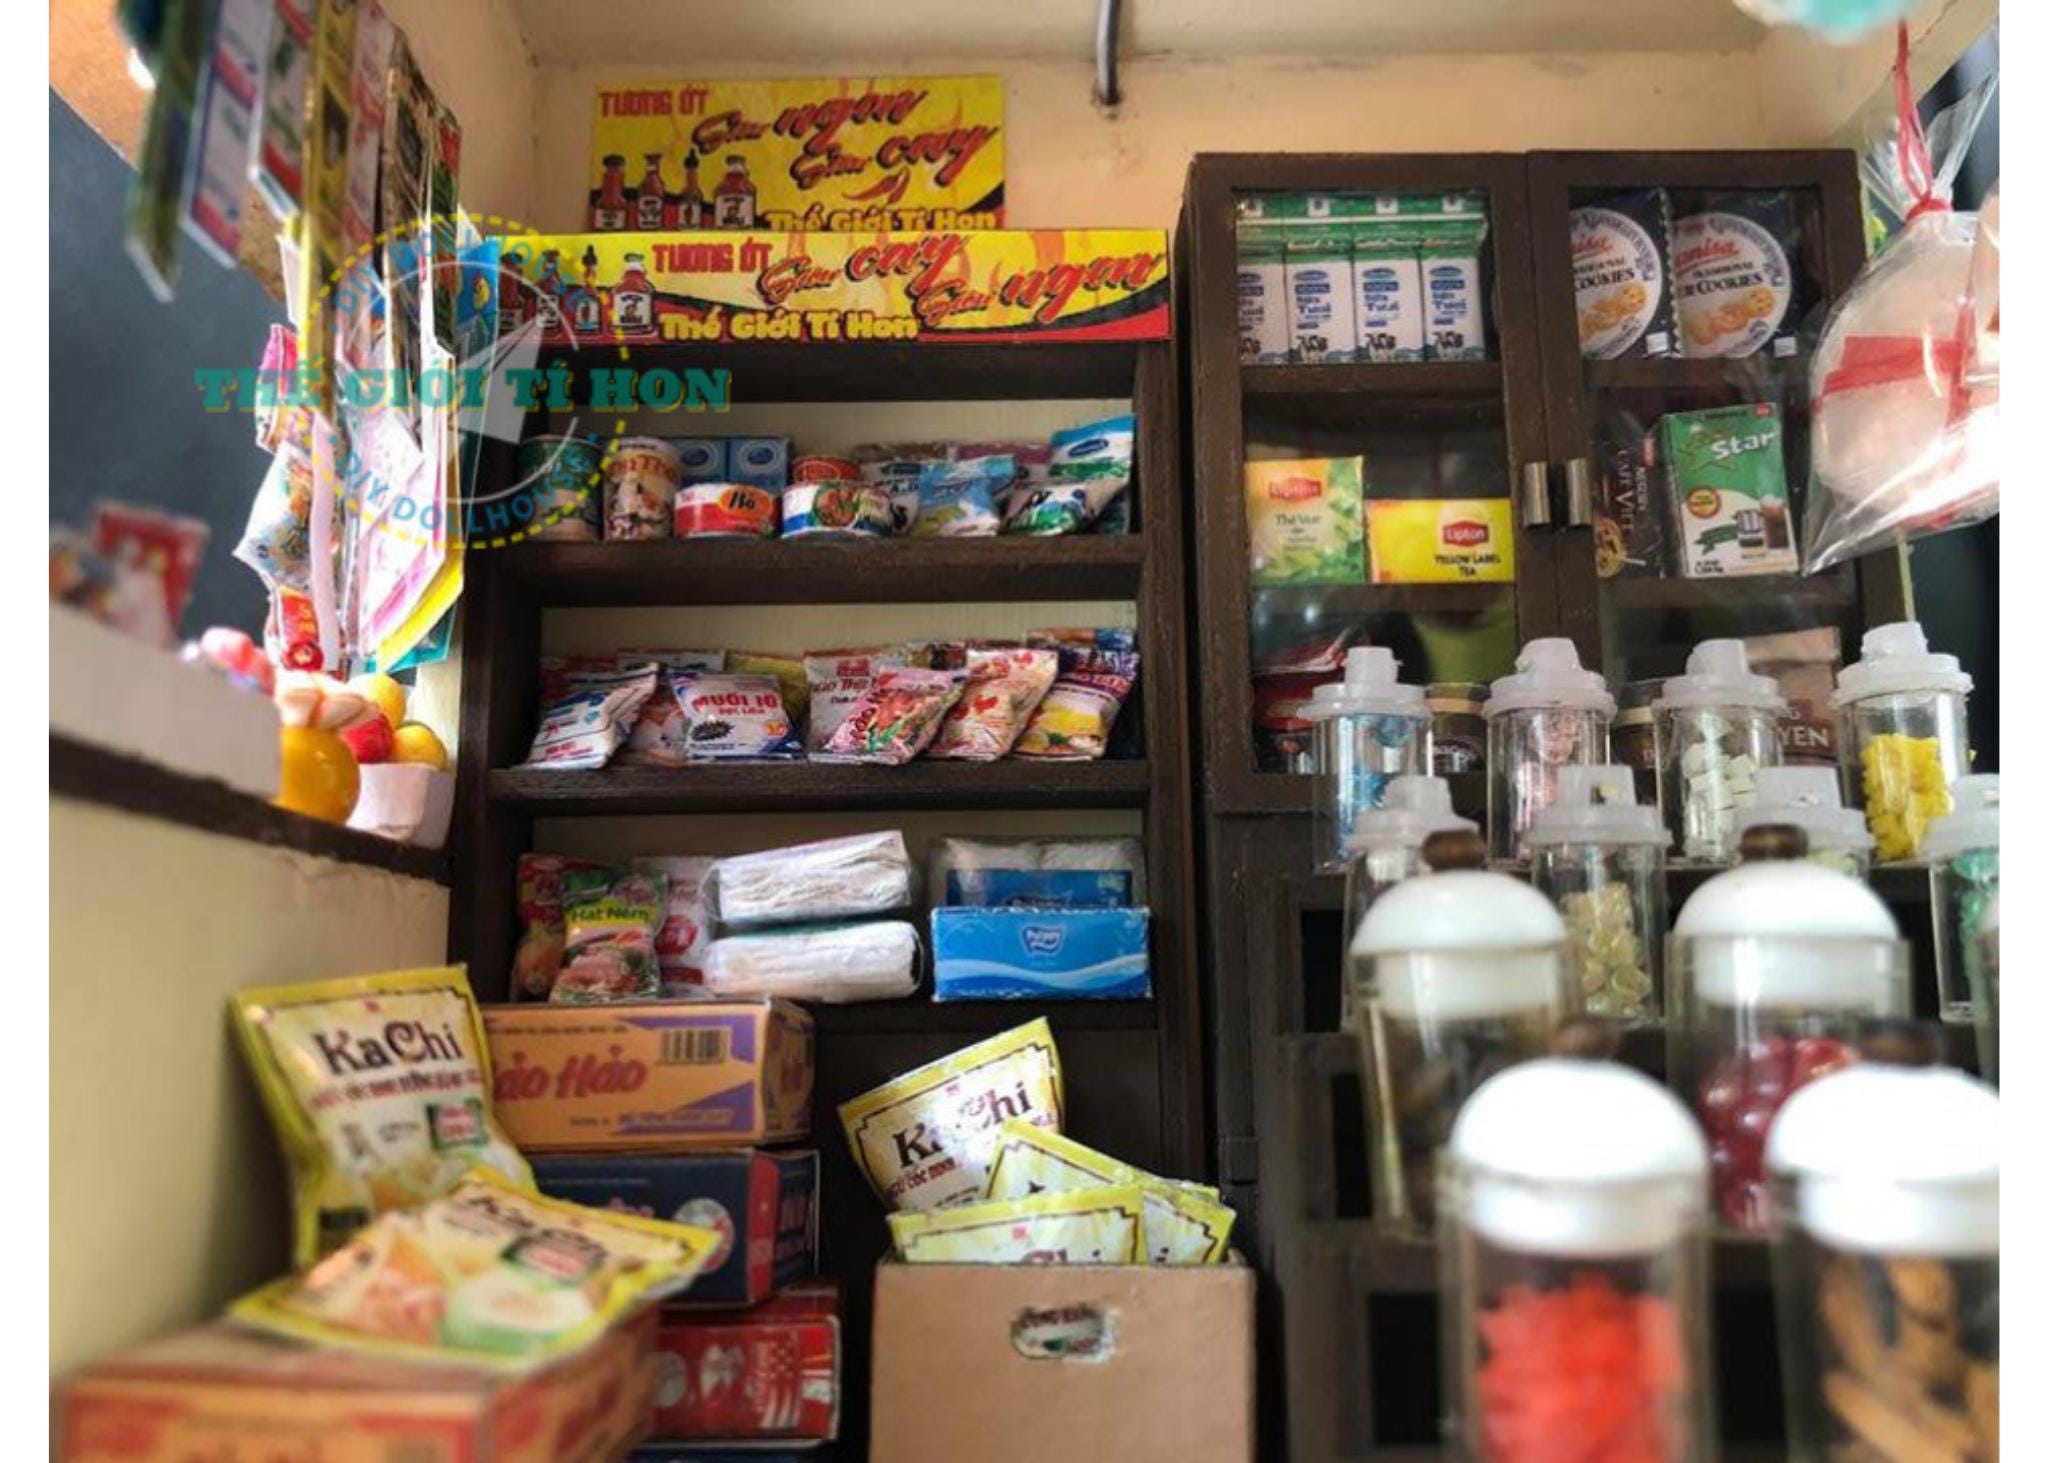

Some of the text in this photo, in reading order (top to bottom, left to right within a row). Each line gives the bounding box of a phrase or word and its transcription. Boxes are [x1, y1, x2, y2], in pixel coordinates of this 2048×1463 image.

[876, 124, 999, 188] cay
[846, 232, 972, 299] cay
[1001, 253, 1166, 324] ngon
[845, 311, 921, 341] Hon
[1711, 431, 1776, 459] Star
[1446, 525, 1486, 545] Lipton
[1434, 553, 1501, 565] YELLOW LABEL
[1459, 566, 1477, 577] TEA
[313, 1020, 464, 1075] KaChi
[494, 1050, 550, 1100] ảo
[554, 1045, 649, 1099] Hảo
